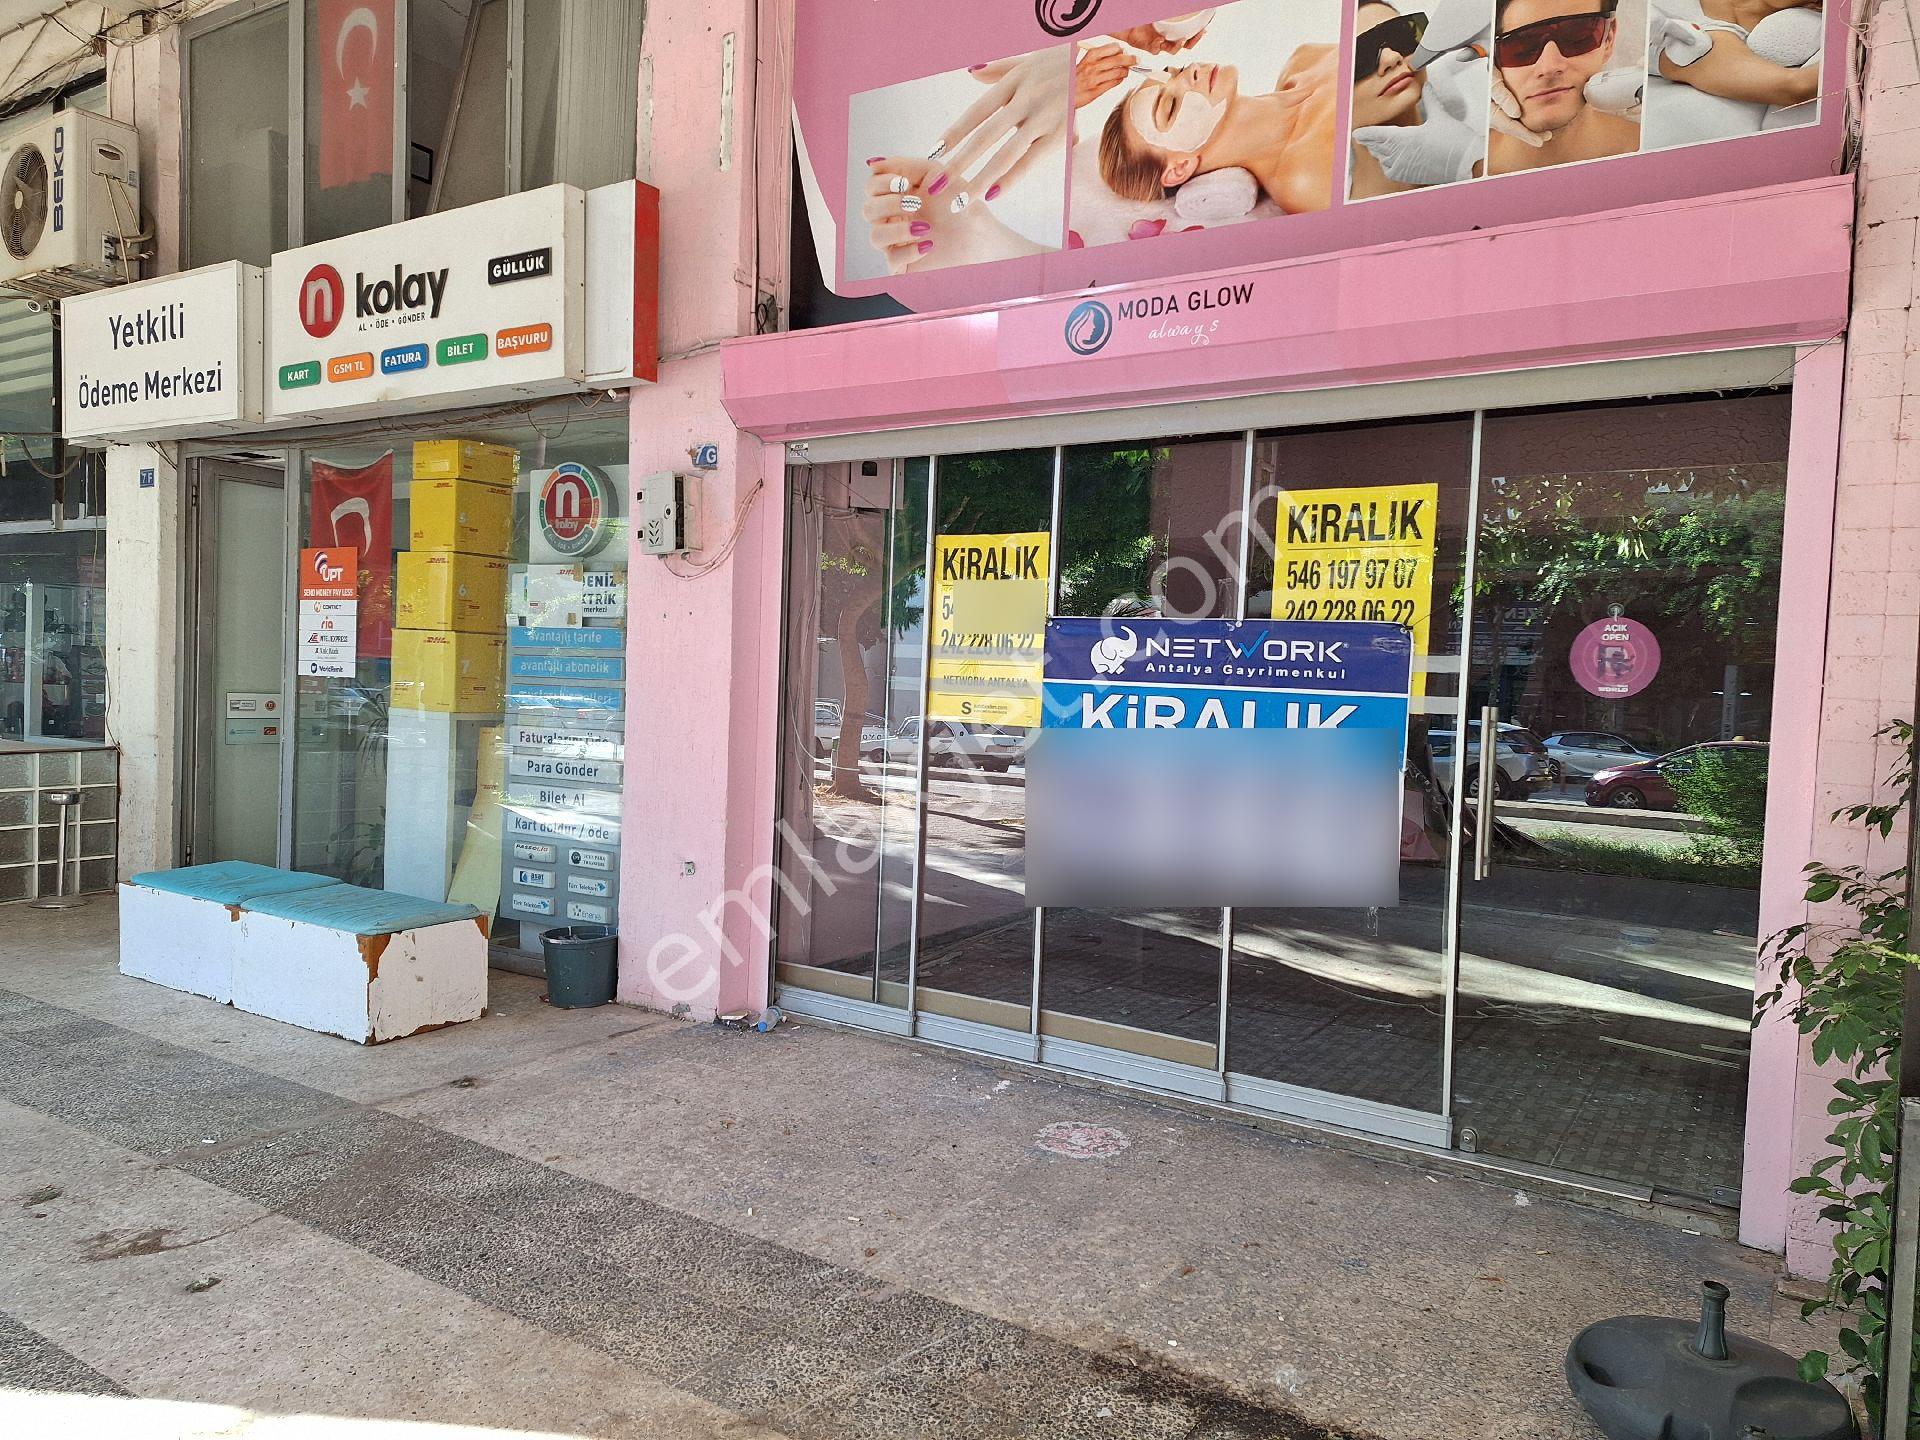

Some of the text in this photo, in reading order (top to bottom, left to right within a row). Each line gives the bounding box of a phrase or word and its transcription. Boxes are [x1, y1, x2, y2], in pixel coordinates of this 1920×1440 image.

[53, 126, 65, 233] BEKO
[492, 254, 545, 278] GÜLLÜK
[356, 263, 449, 318] kolay
[1118, 283, 1255, 321] MODA GLOW
[109, 303, 184, 350] Yetkili
[358, 312, 426, 332] AL ÖDE GÖNDER
[497, 331, 548, 350] BAŞVURU
[1148, 319, 1219, 346] always
[384, 351, 422, 367] FATURA
[447, 342, 475, 357] BİLET
[287, 368, 310, 381] KART
[333, 360, 365, 375] GSM TL
[79, 360, 222, 409] Ödeme Merkezi
[1287, 499, 1425, 544] KiRALIK
[942, 545, 1041, 581] KiRALIK
[1287, 558, 1418, 590] 546 197 97 07
[1285, 600, 1415, 625] 242 228 06 22
[1601, 633, 1630, 641] OPEN
[1603, 624, 1628, 633] AÇIK
[1145, 630, 1343, 663] NETWORK
[565, 660, 610, 675] abonelik
[1145, 662, 1346, 680] Antalya Gayrimenkul
[943, 674, 1029, 689] NETWORK ANTALYA
[527, 760, 599, 777] Para Gönder
[540, 790, 567, 804] Bilet
[515, 818, 537, 832] Kart
[587, 826, 609, 839] öde
